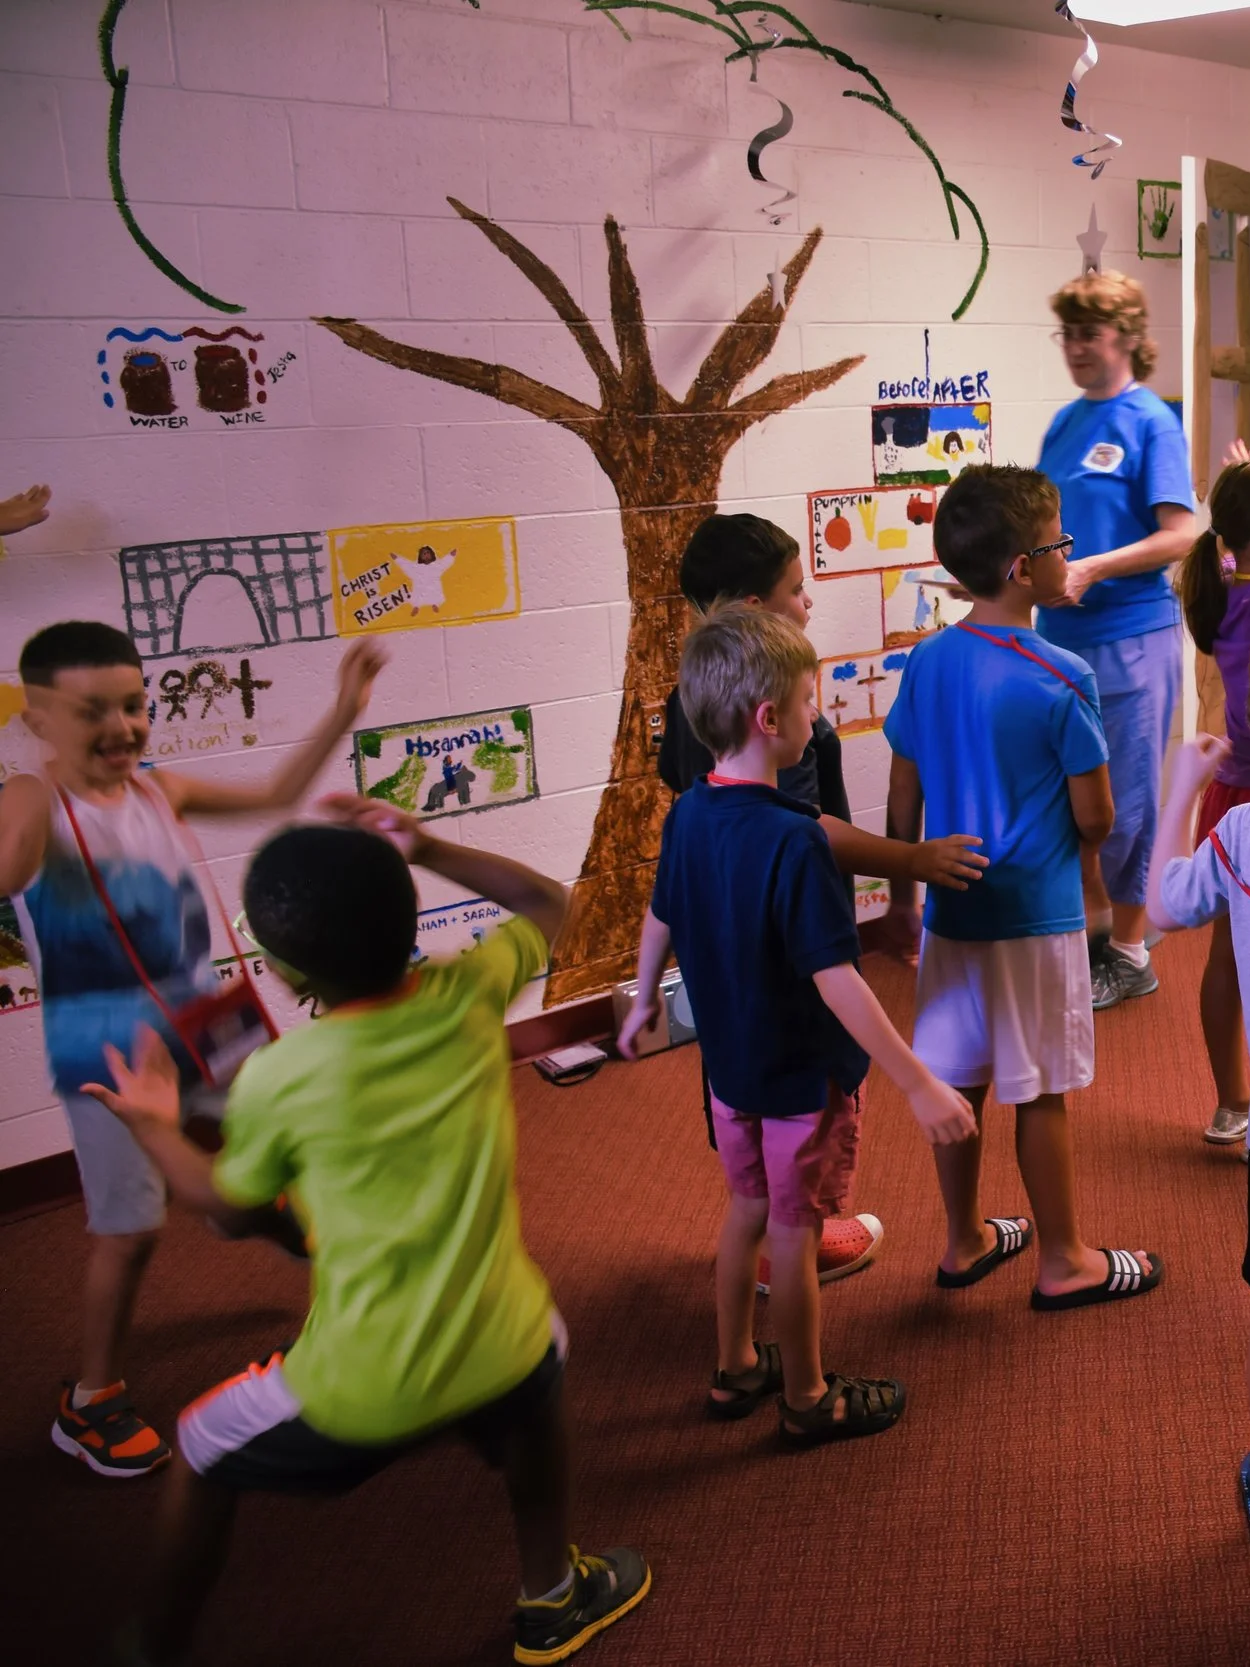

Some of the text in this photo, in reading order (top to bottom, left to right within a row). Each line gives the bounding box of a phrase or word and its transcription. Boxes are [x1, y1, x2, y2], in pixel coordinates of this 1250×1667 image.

[170, 360, 187, 372] TO
[130, 416, 189, 429] WATER
[220, 411, 266, 425] WINE
[341, 562, 390, 597] CHRIST
[354, 583, 411, 626] RISEN!
[462, 907, 500, 923] SARAH
